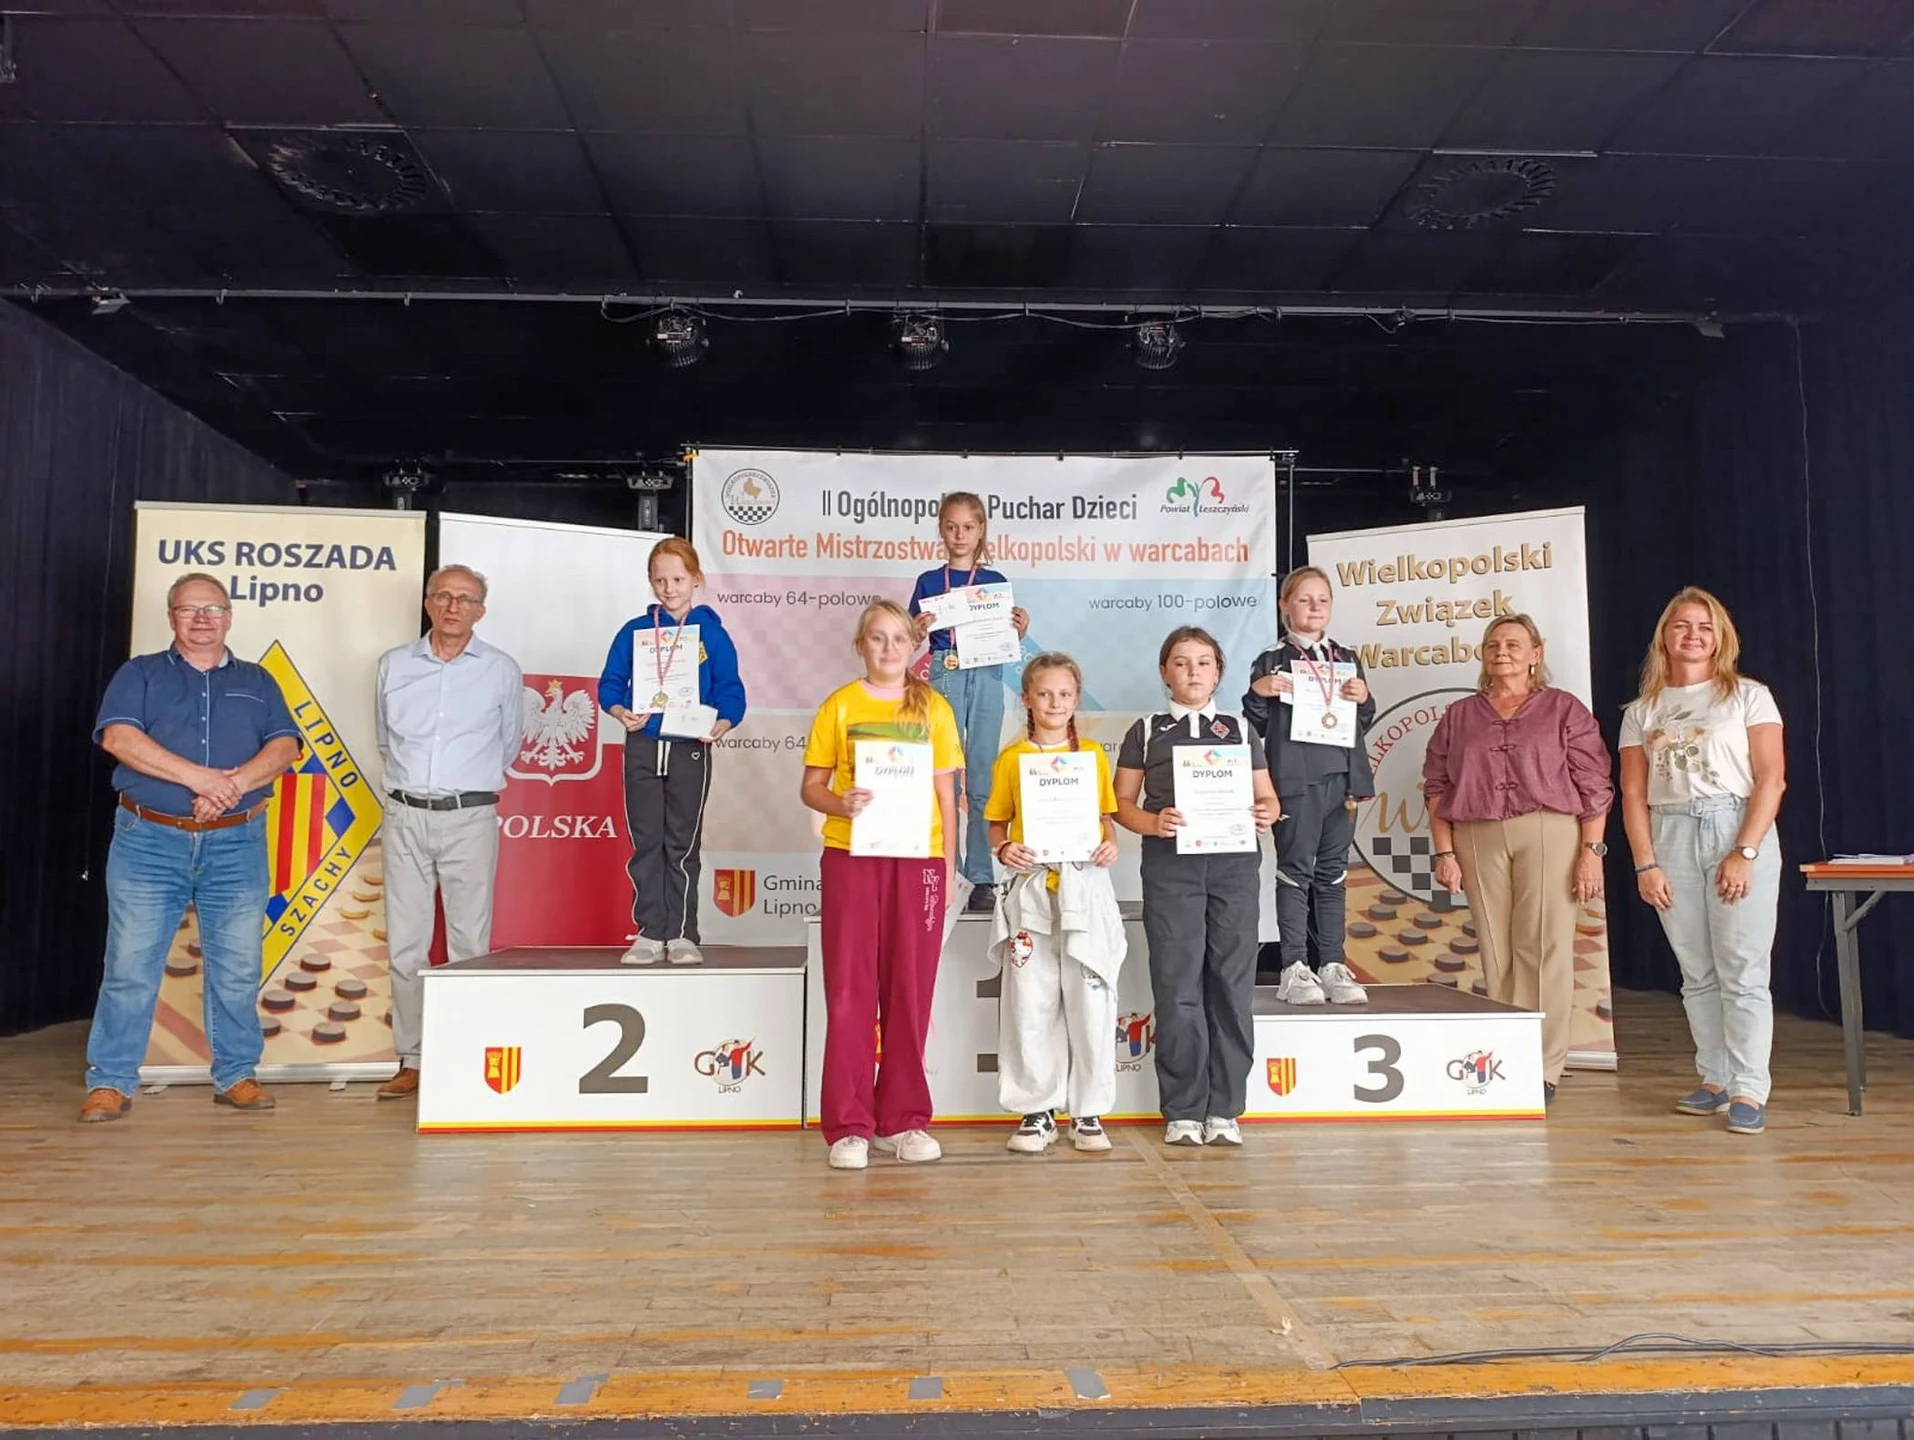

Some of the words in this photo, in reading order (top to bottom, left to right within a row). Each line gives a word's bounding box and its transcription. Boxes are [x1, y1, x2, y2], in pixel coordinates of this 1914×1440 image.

[822, 490, 831, 516] II
[837, 490, 979, 524] Ogólnopo
[988, 494, 1064, 520] Puchar
[1072, 494, 1137, 520] Dzieci
[1160, 505, 1190, 513] Powiat
[1199, 504, 1249, 515] Leszczyński
[158, 539, 226, 567] UKS
[235, 541, 397, 571] ROSZADA
[722, 529, 808, 557] Otwarte
[985, 533, 1095, 567] elkopolski
[1103, 543, 1121, 562] w
[1129, 536, 1249, 562] warcabach
[1336, 542, 1553, 588] Wielkopolski
[229, 575, 324, 607] Lipno
[717, 590, 782, 608] warcaby
[1089, 595, 1152, 612] warcaby
[1157, 594, 1257, 613] 100-polowe
[1375, 590, 1516, 627] Związek
[1351, 636, 1485, 670] Warcab
[294, 700, 358, 788] LIPNO
[716, 736, 781, 753] warcaby
[1039, 777, 1079, 787] DYPLOM
[1193, 769, 1233, 778] DYPLOM
[280, 846, 352, 936] SZACHY
[763, 875, 822, 891] Gmina
[764, 899, 817, 919] Lipno
[579, 1003, 648, 1094] 2
[1353, 1034, 1405, 1103] 3
